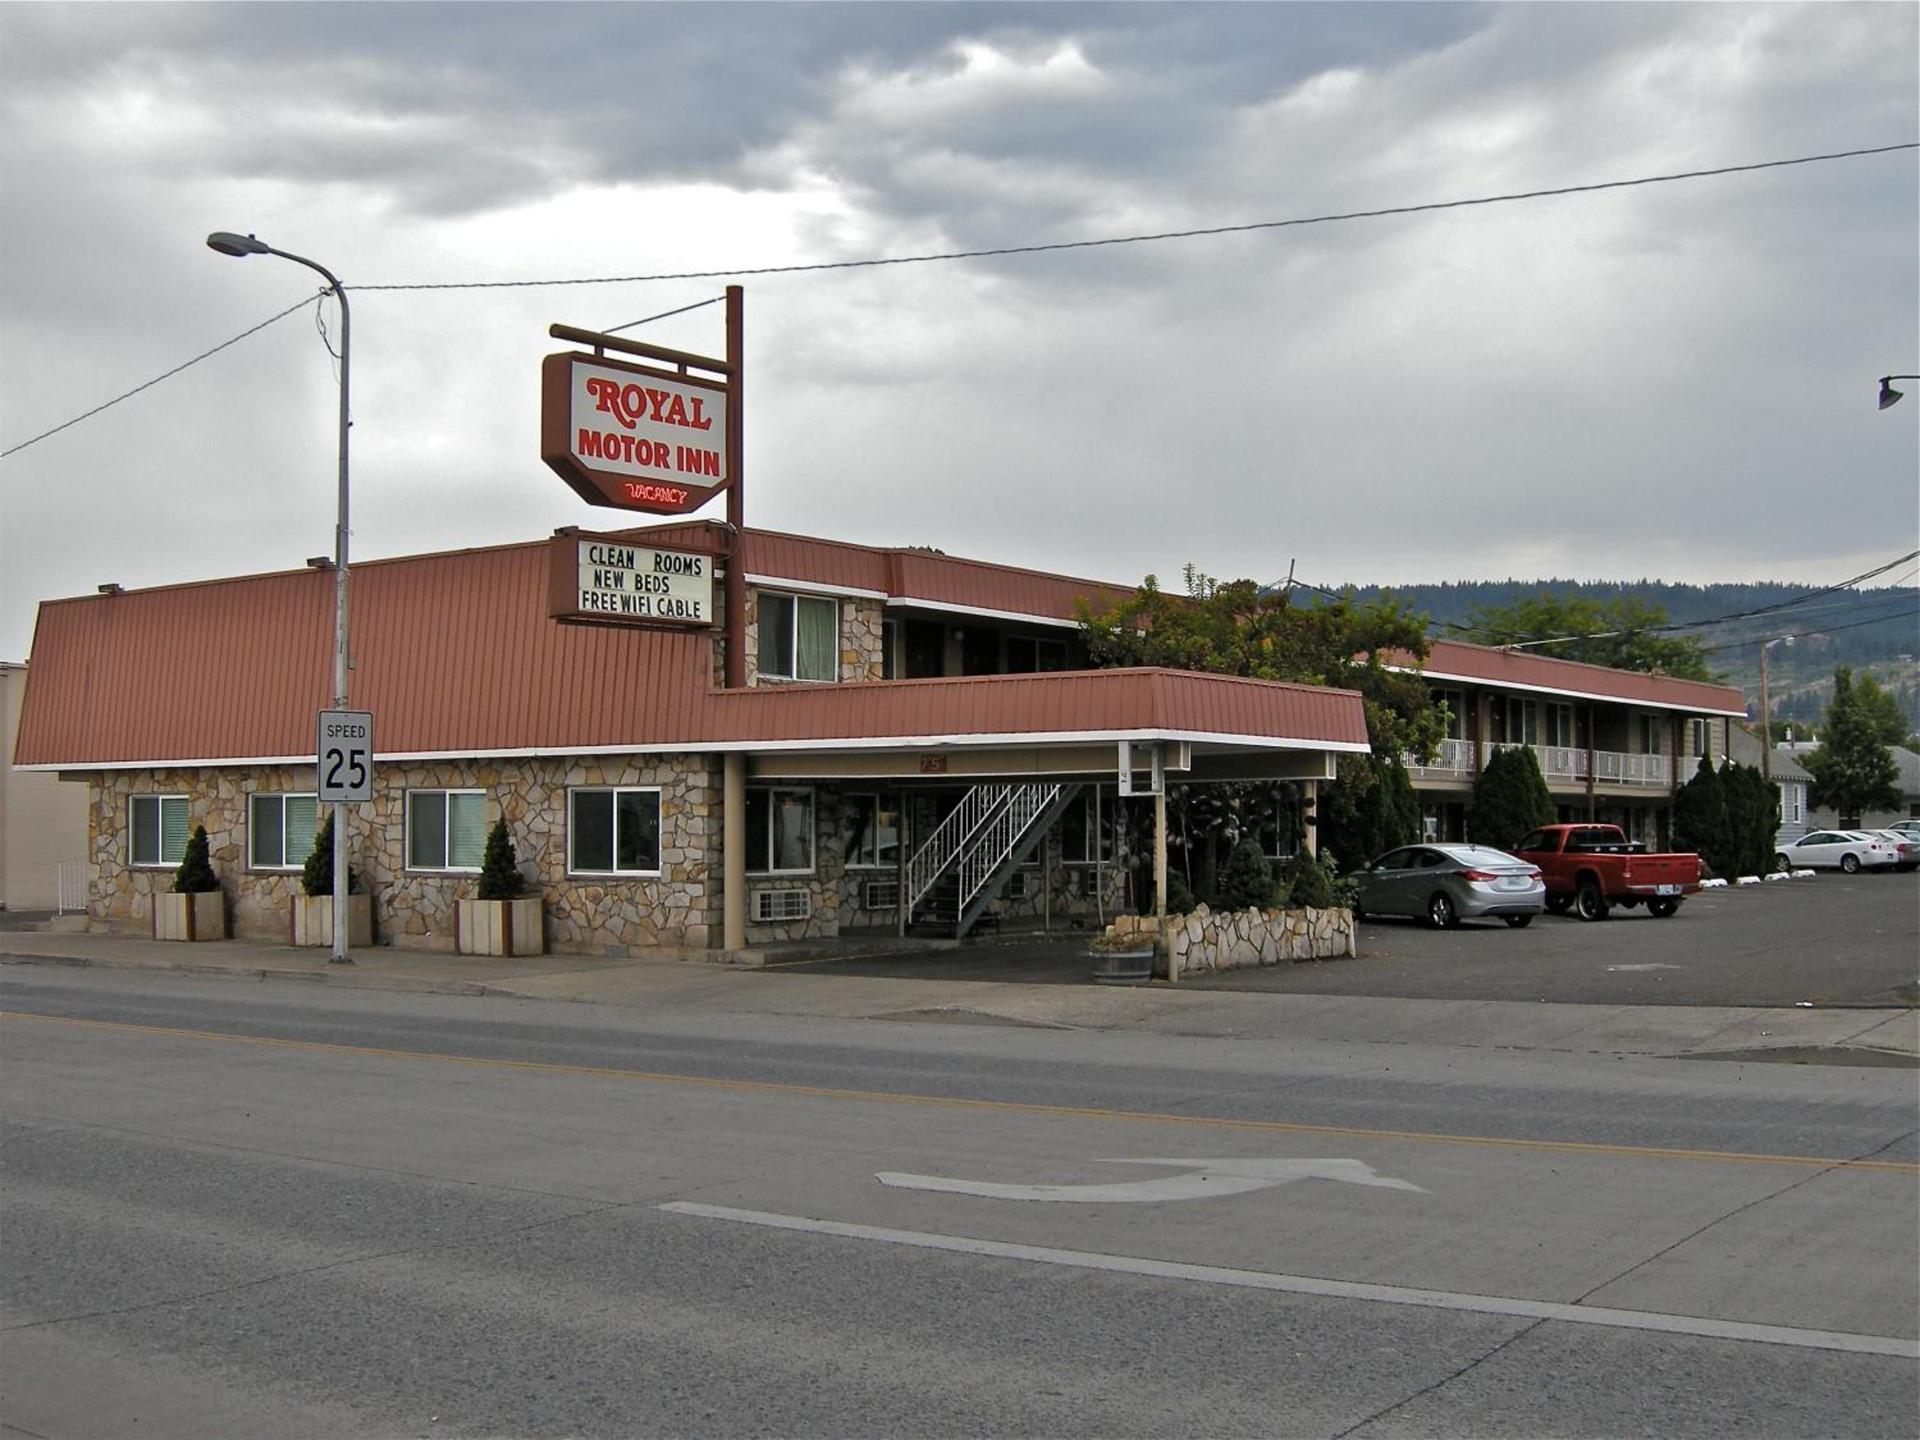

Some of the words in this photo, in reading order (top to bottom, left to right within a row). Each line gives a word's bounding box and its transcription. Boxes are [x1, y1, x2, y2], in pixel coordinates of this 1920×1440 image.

[586, 377, 713, 431] ROYAL
[578, 428, 671, 469] MOTOR
[676, 445, 720, 477] INN
[624, 482, 688, 504] VACANCY
[589, 546, 634, 569] CLEAN
[654, 552, 702, 575] ROOMS
[594, 569, 624, 589] NEW
[635, 573, 670, 593] BEDS
[582, 590, 617, 611] FREE
[620, 592, 651, 614] WIFI
[657, 597, 701, 619] CABLE
[327, 724, 366, 738] SPEED
[326, 748, 366, 789] 25
